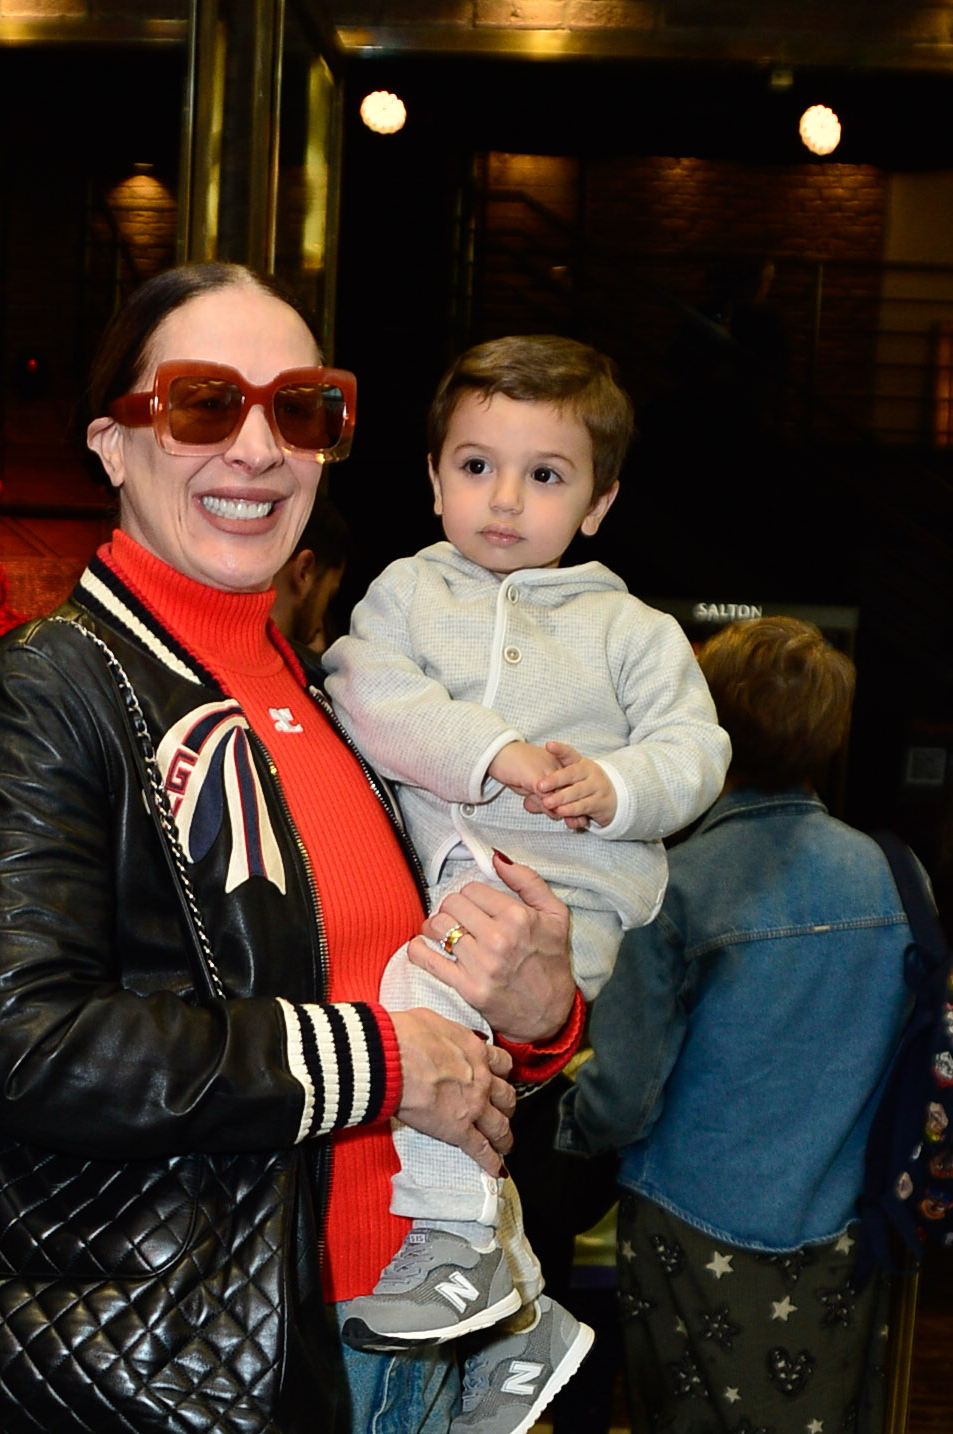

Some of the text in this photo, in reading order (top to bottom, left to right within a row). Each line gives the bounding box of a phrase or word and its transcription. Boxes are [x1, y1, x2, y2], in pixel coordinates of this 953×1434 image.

[697, 602, 762, 618] SALTON
[434, 1271, 480, 1313] N
[501, 1361, 545, 1395] N
